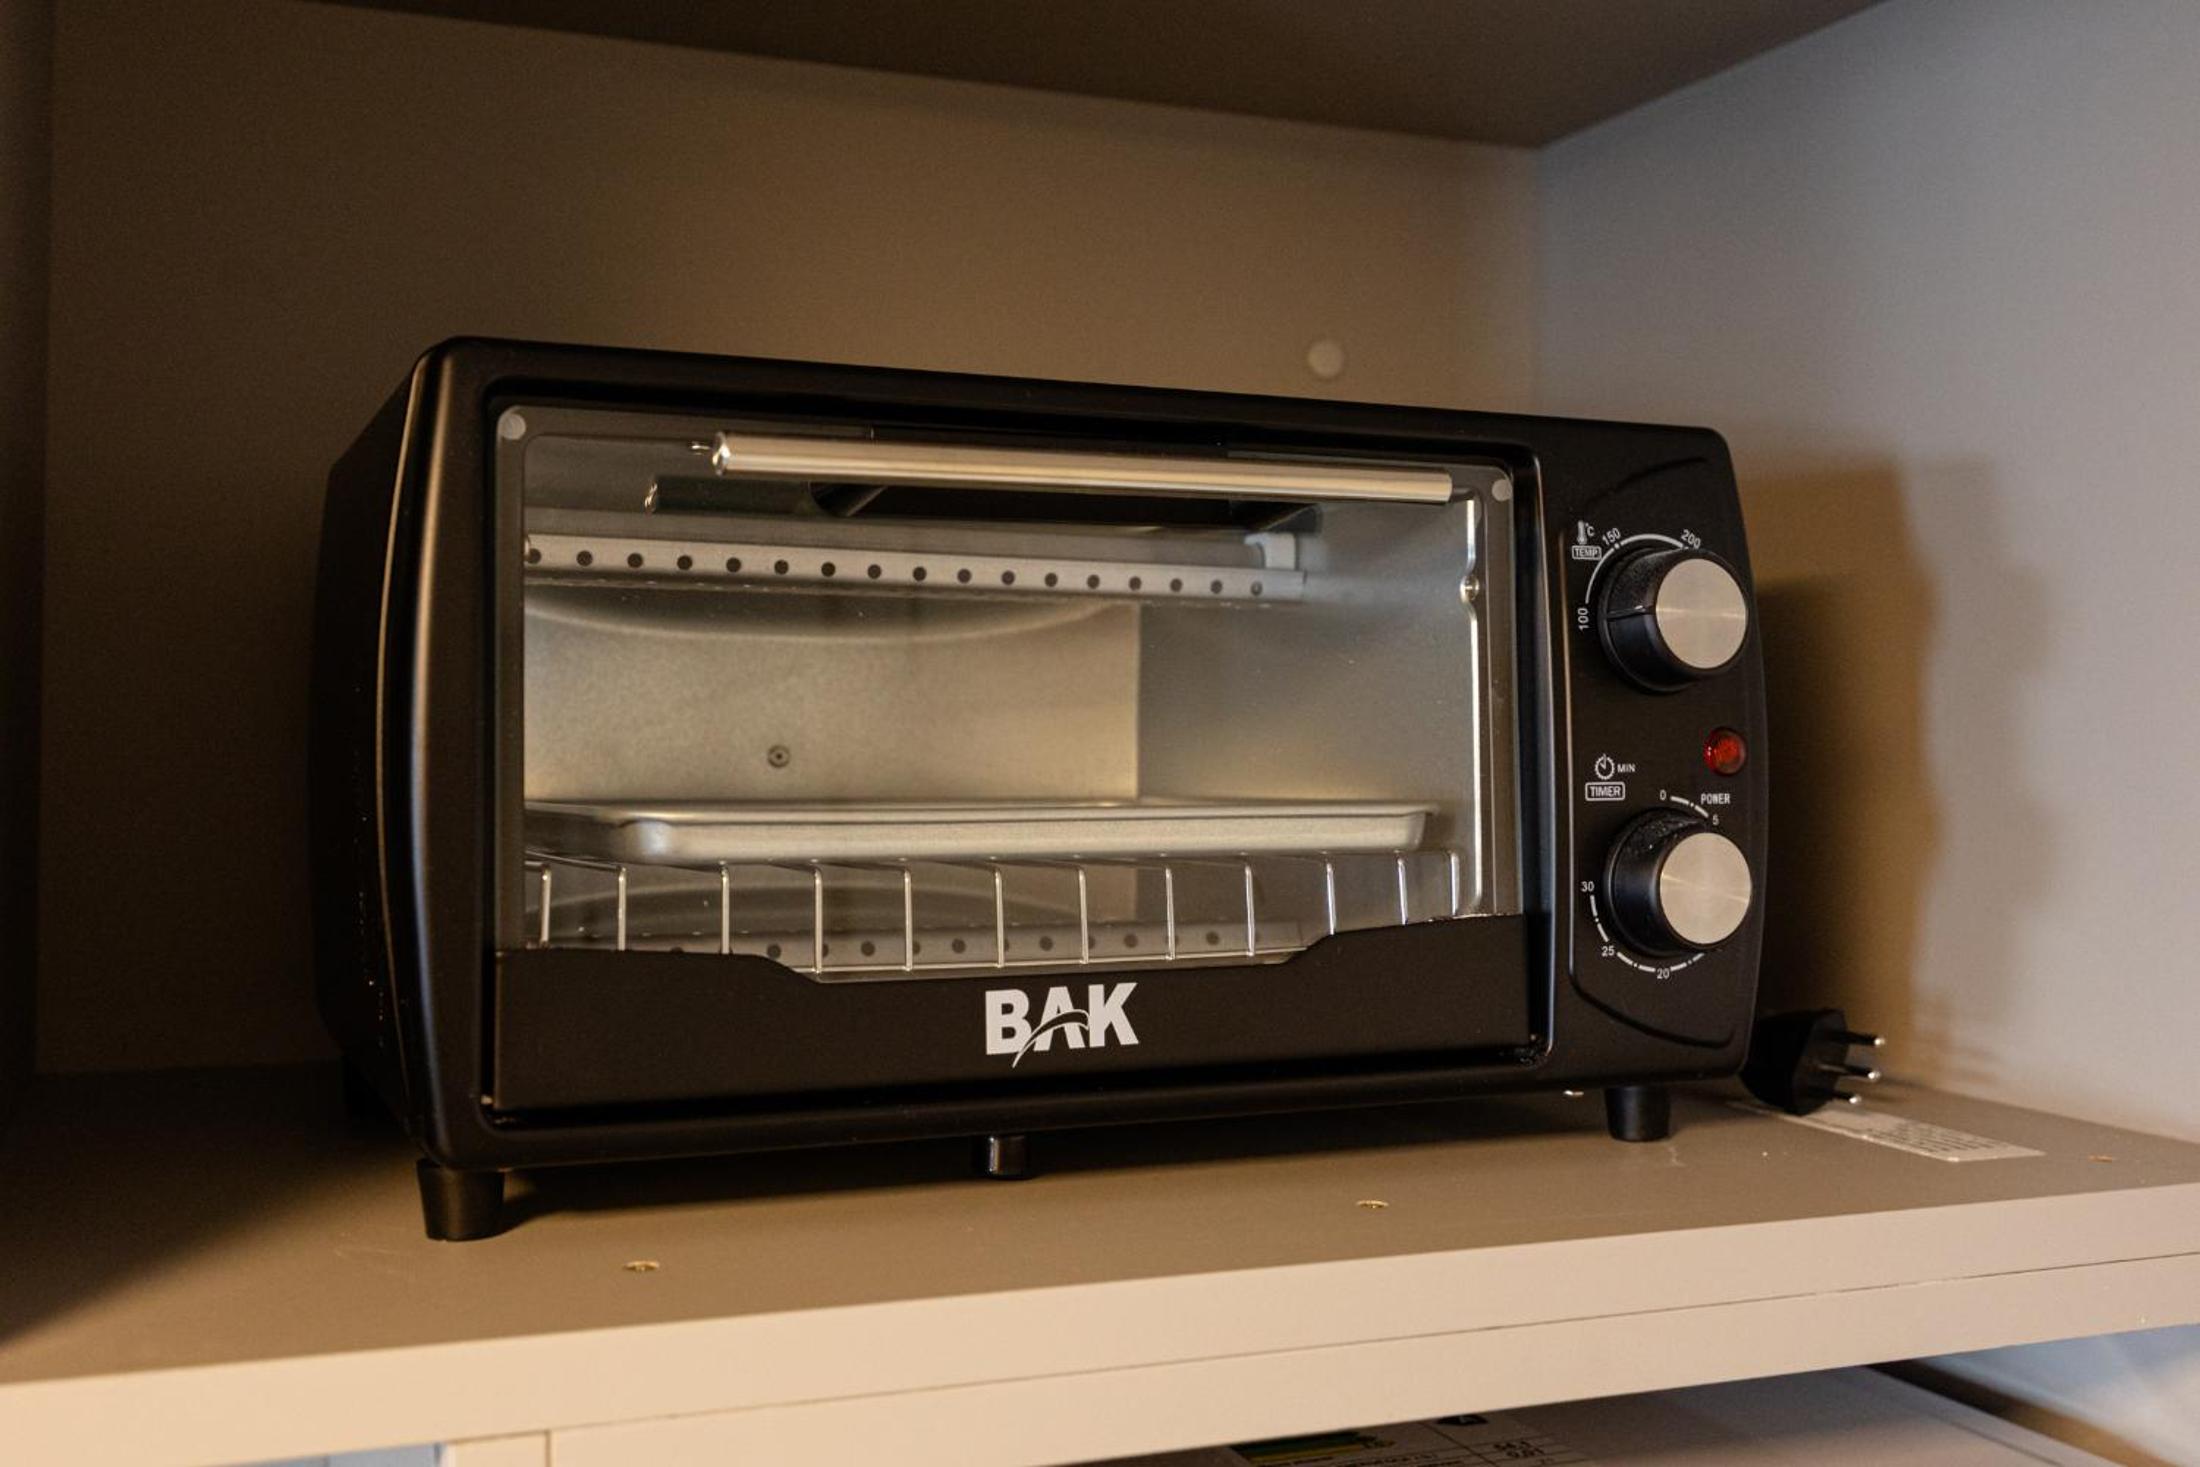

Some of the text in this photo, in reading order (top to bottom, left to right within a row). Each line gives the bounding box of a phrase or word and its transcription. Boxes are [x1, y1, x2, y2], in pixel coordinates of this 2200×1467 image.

[1602, 527, 1620, 545] 150
[1681, 529, 1701, 549] 200
[1574, 548, 1598, 557] TEMP
[1577, 608, 1589, 631] 100
[1617, 763, 1636, 773] MIN
[1590, 786, 1621, 797] TIMER
[1659, 790, 1667, 801] 0
[1701, 793, 1731, 805] POWER
[1712, 815, 1719, 825] 5
[1581, 881, 1595, 893] 30
[1601, 945, 1615, 957] 25
[1656, 967, 1670, 979] 20
[985, 982, 1139, 1056] BAK
